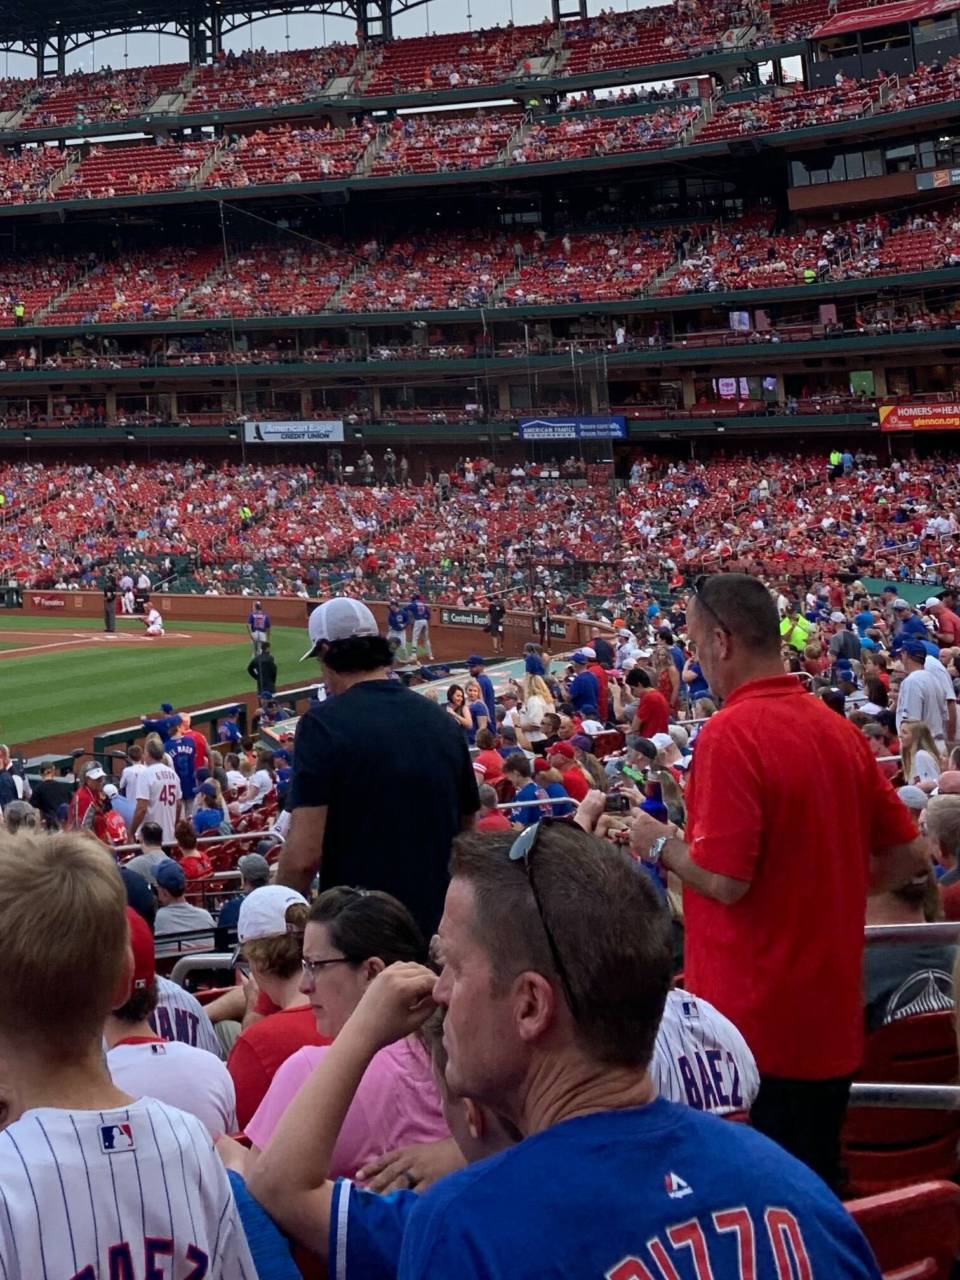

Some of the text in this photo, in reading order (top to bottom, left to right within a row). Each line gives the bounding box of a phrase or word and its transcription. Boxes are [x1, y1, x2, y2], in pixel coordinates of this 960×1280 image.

[897, 407, 932, 416] HOMERS
[942, 405, 960, 415] HEA
[451, 612, 474, 624] Central
[160, 784, 177, 806] 45
